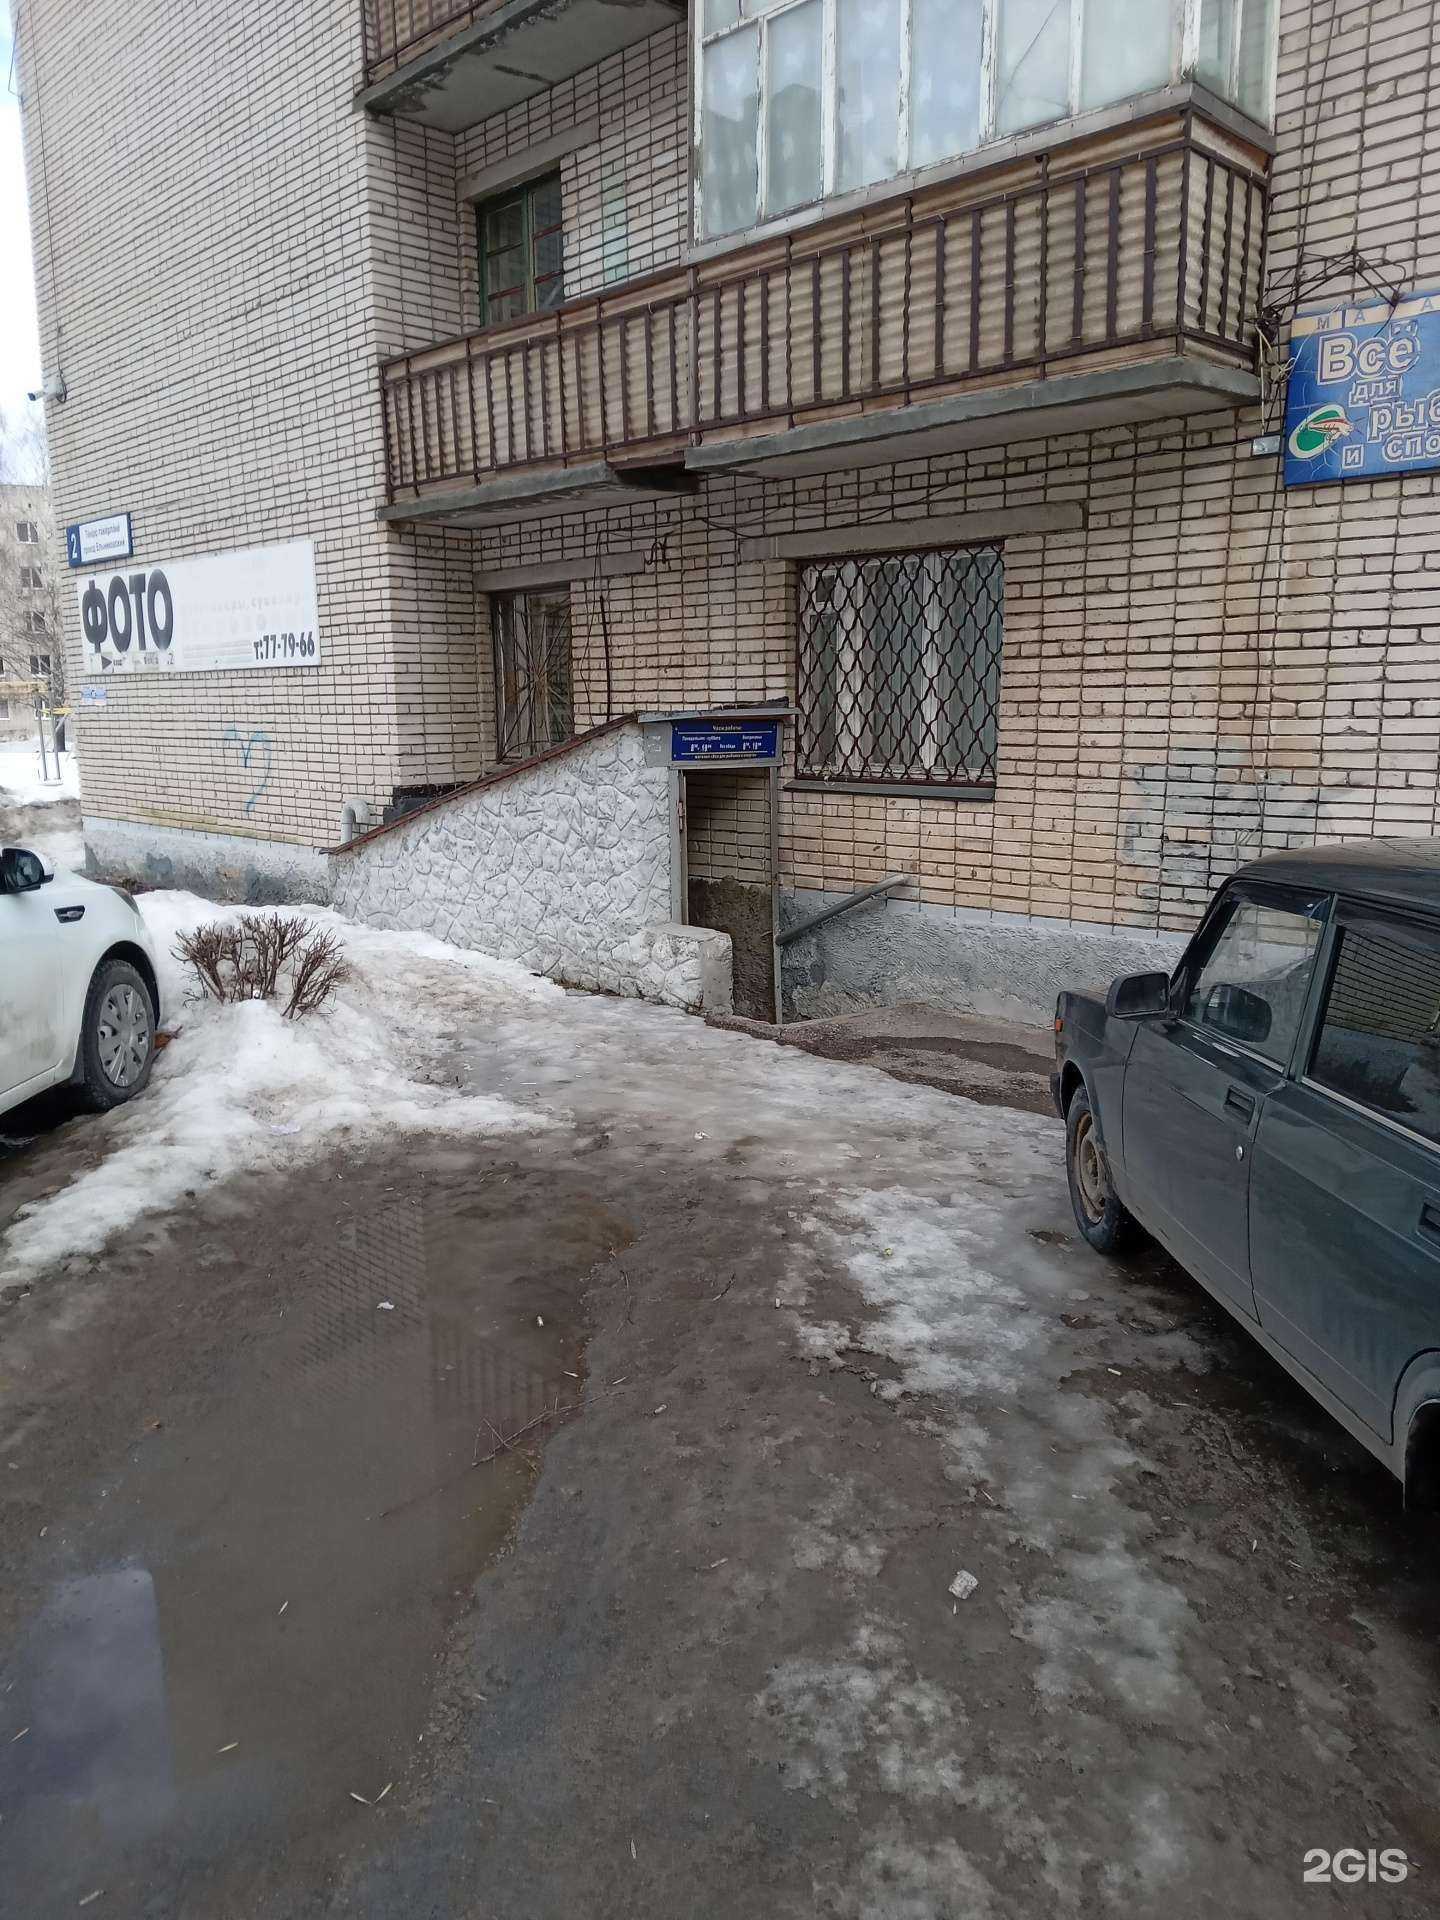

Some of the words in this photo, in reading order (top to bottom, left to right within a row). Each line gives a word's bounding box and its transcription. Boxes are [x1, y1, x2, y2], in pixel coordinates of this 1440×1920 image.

[1318, 320, 1420, 384] Всё
[1351, 377, 1401, 405] для
[1343, 445, 1363, 467] и
[70, 533, 78, 559] 2
[82, 568, 174, 654] ФОТО
